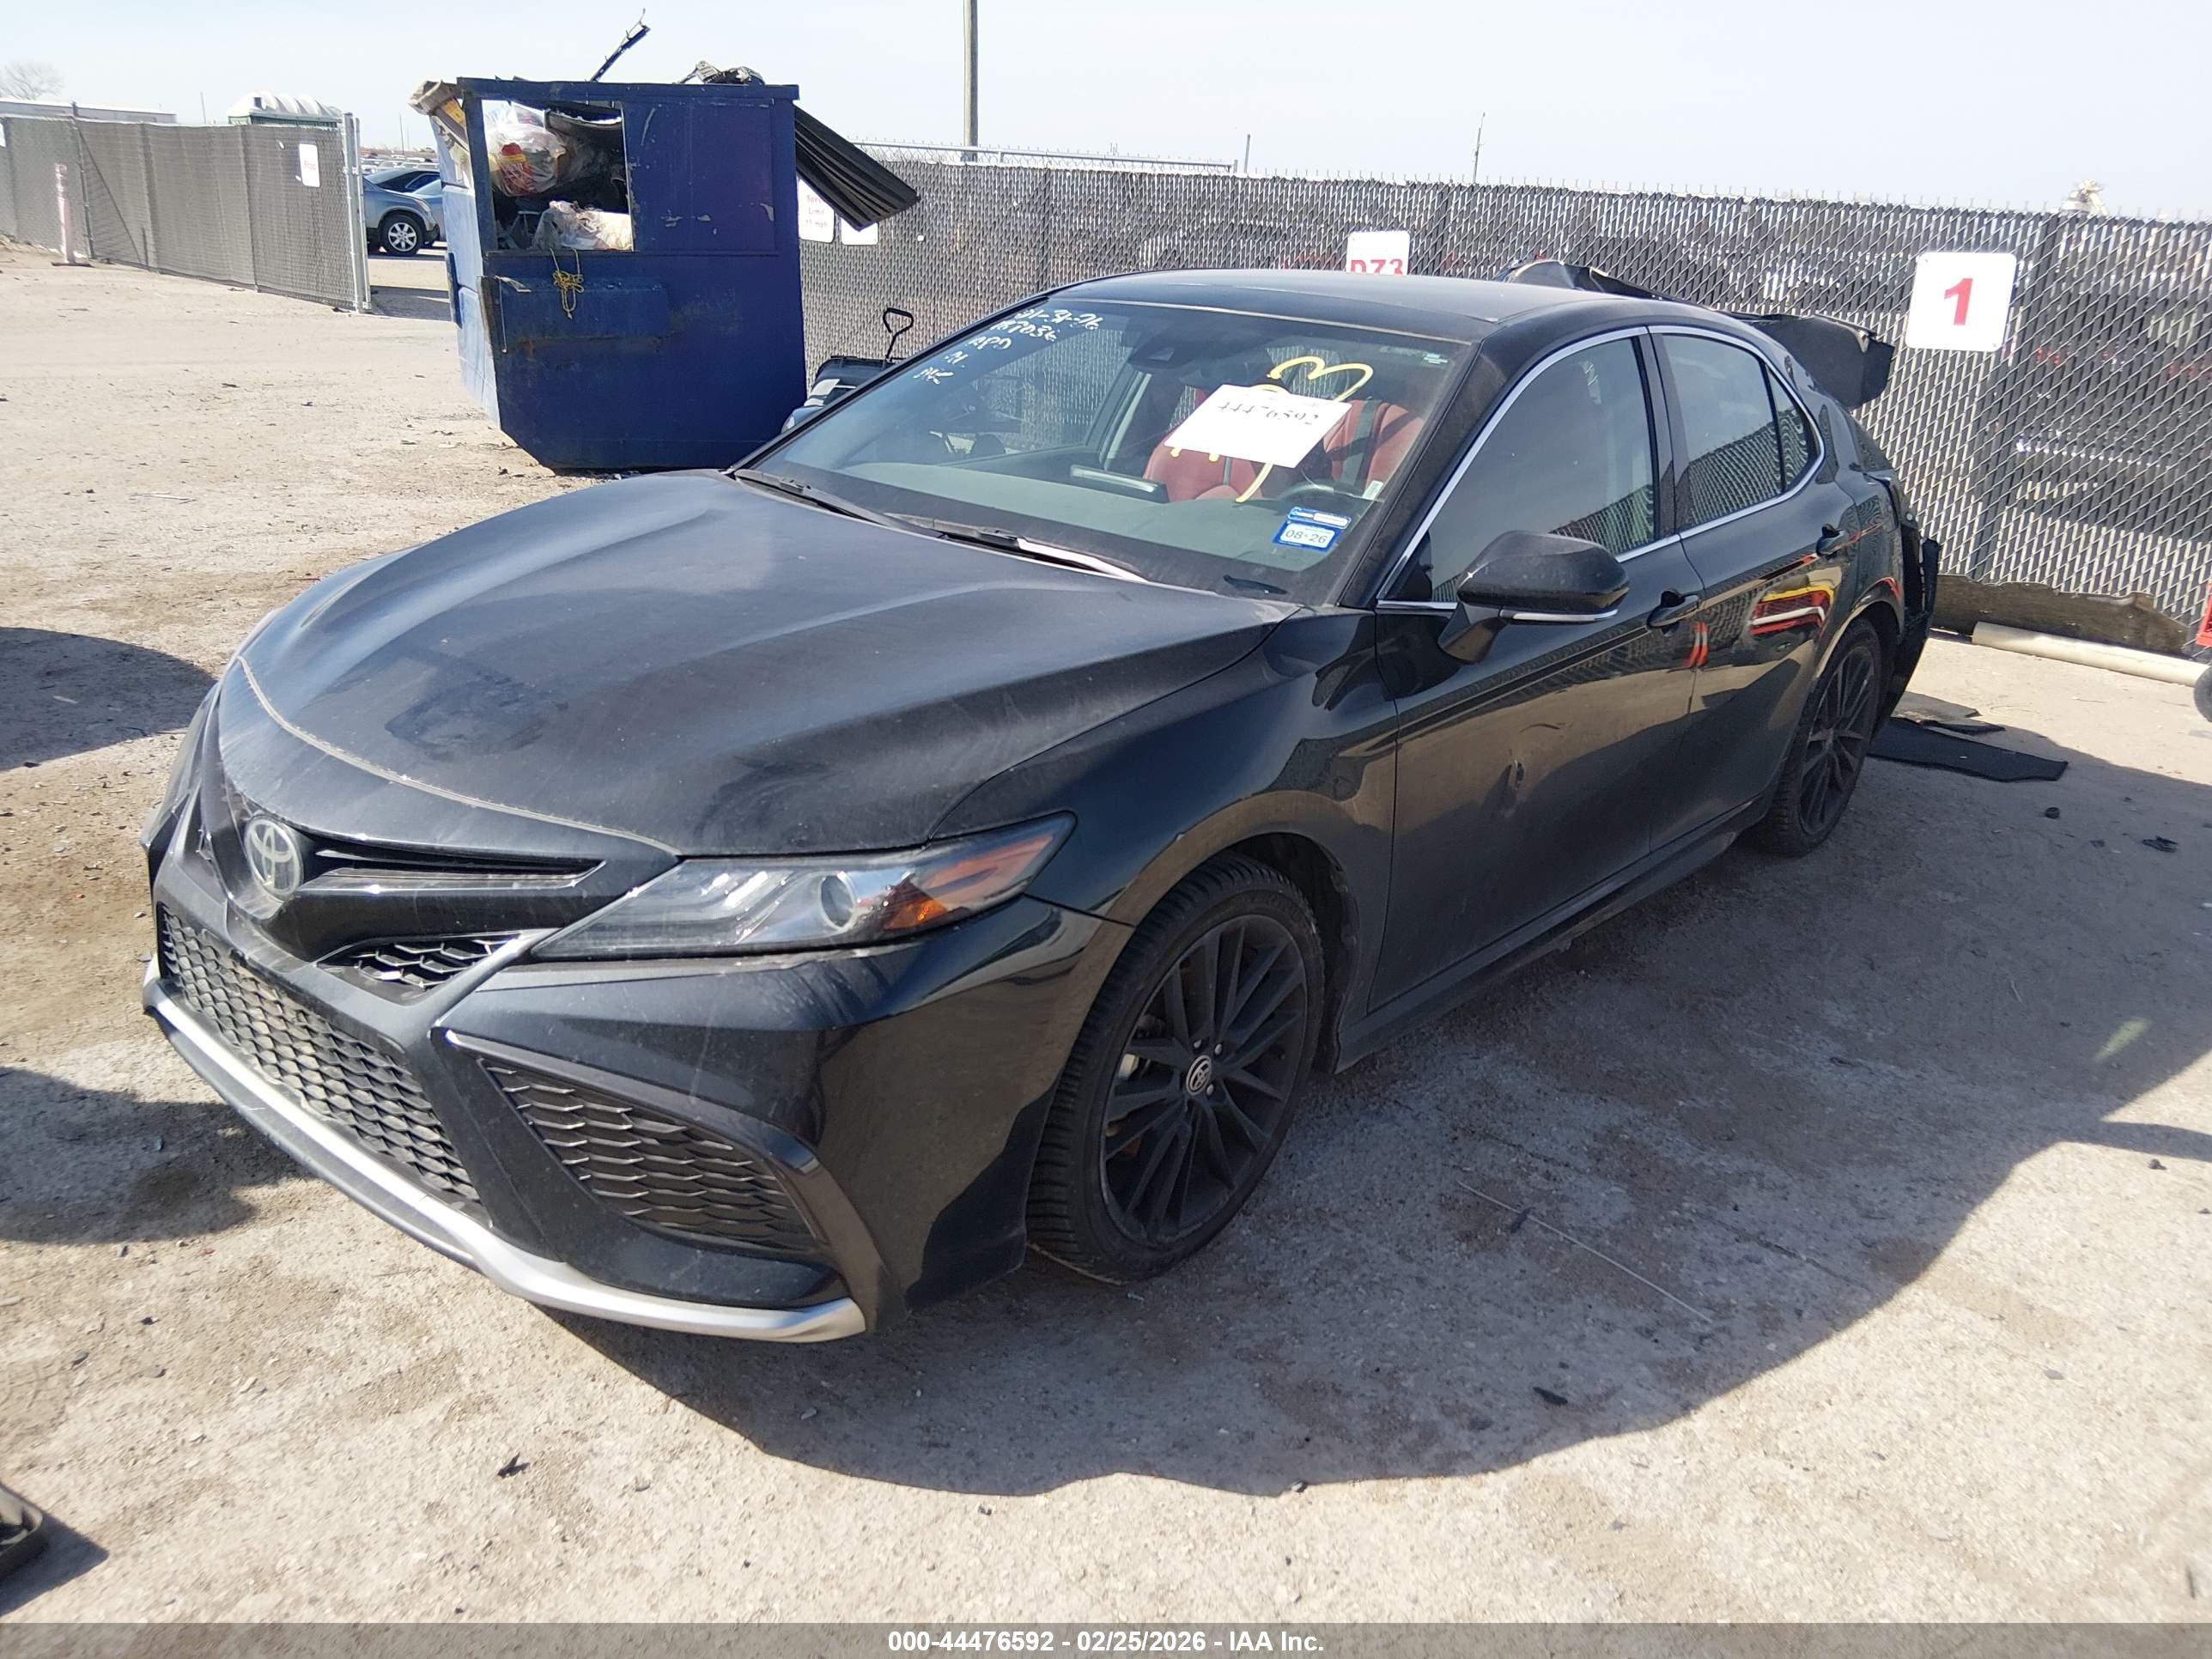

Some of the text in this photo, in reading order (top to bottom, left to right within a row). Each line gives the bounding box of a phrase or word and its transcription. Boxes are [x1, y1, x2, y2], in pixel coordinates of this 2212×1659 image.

[1944, 277, 1973, 325] 1
[1285, 529, 1304, 539] 08
[1309, 533, 1328, 544] 26
